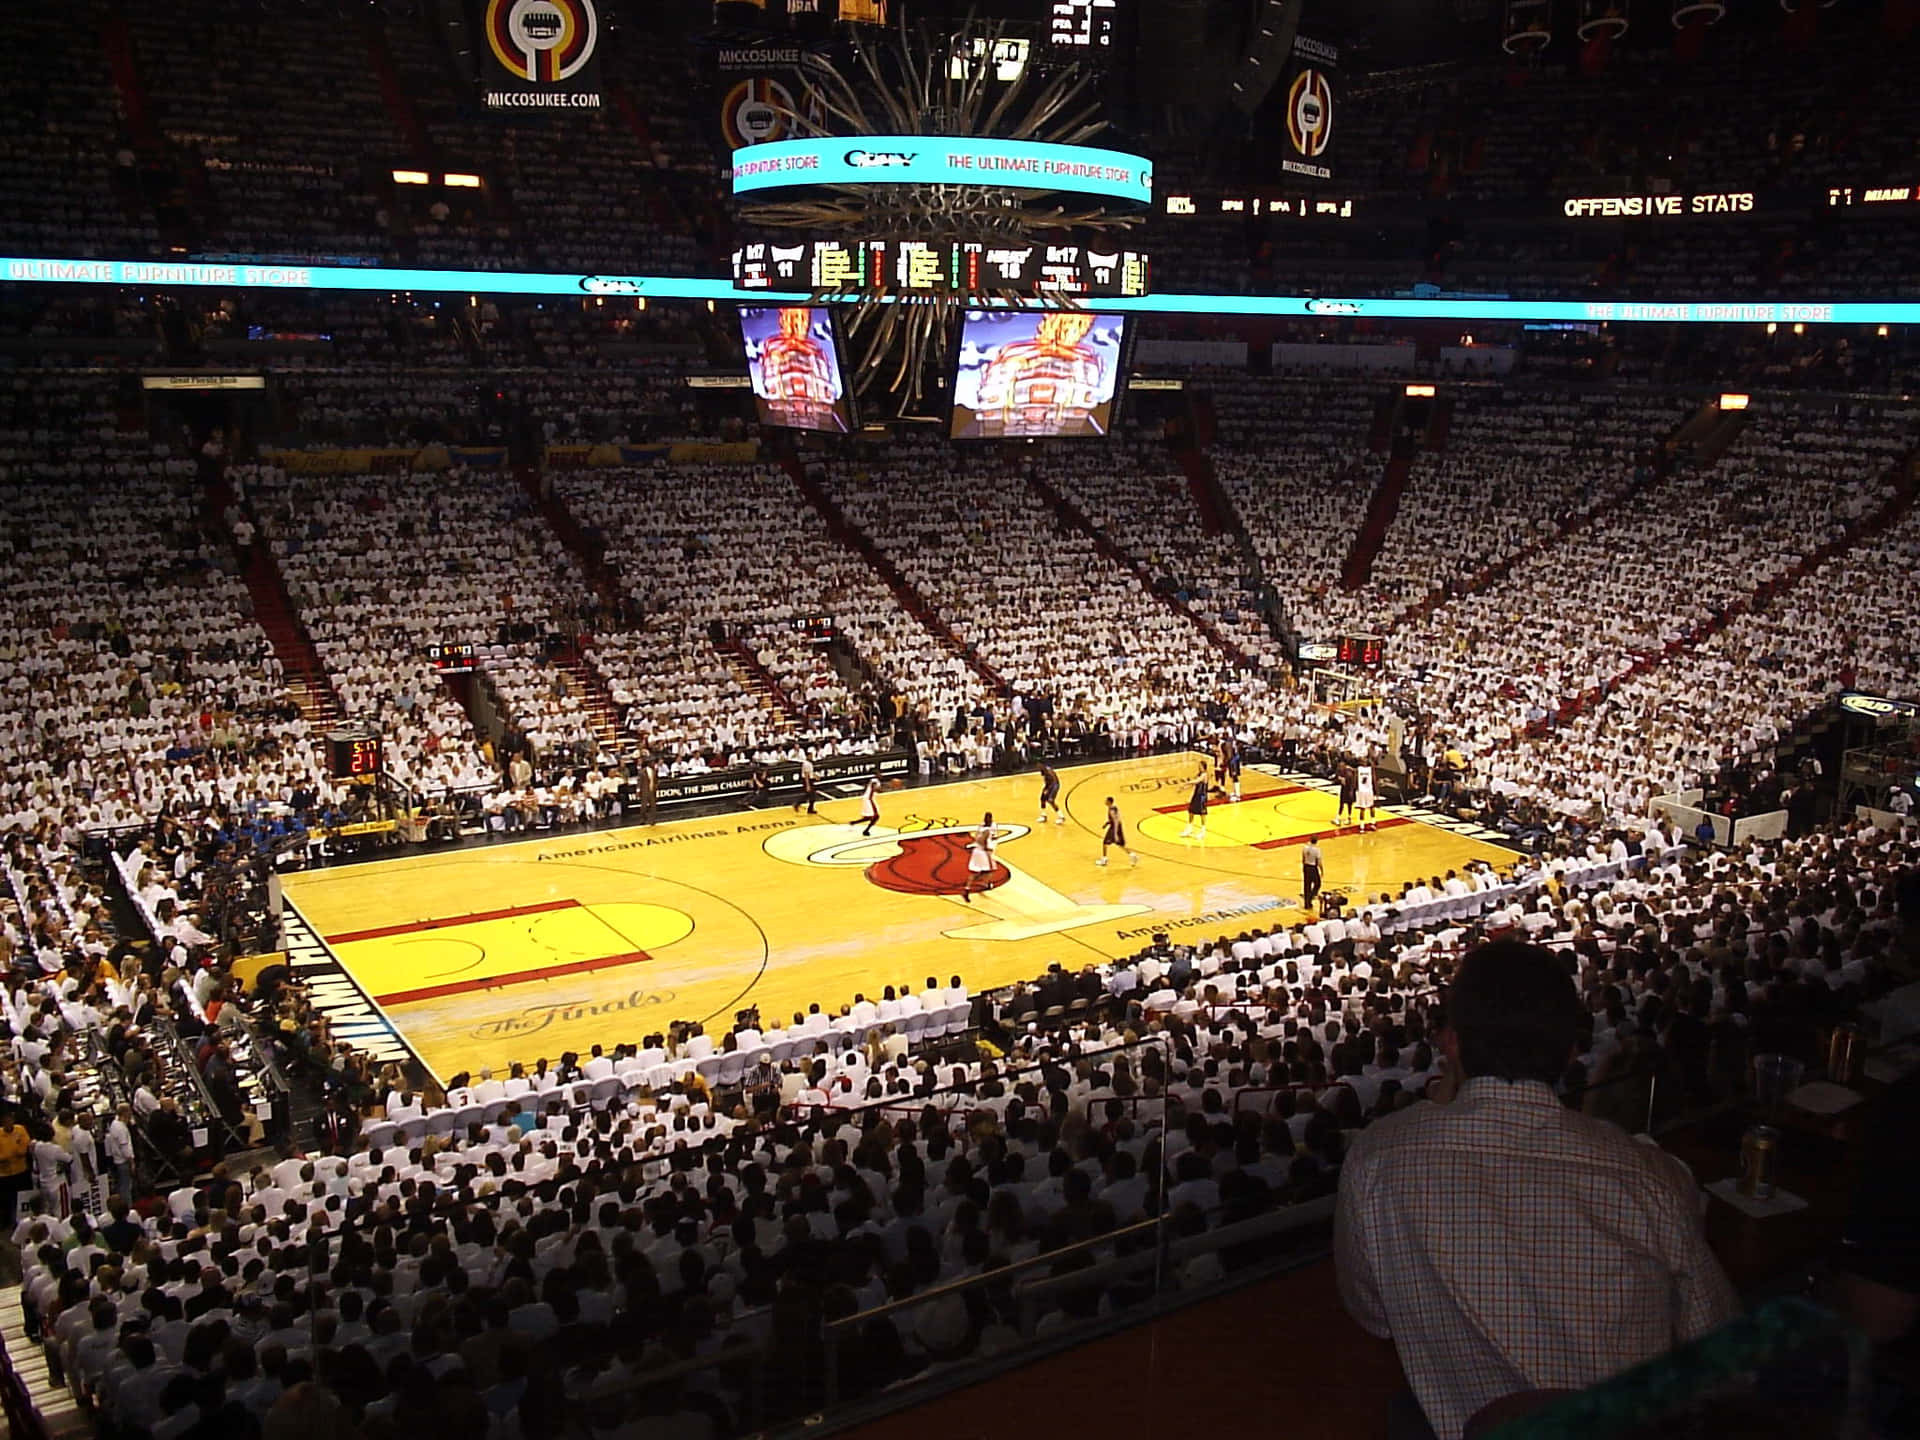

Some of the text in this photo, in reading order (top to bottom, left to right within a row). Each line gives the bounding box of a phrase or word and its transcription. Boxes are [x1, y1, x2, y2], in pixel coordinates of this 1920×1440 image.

[719, 49, 801, 63] MICCOSUKEE
[487, 92, 601, 107] MICCOSUKEE.COM
[785, 155, 819, 170] STORE
[948, 155, 972, 169] THE
[978, 156, 1039, 173] ULTIMATE
[1044, 160, 1103, 179] FURNITURE
[1105, 167, 1129, 183] STORE
[1864, 188, 1910, 202] MIAMI
[1564, 194, 1753, 217] OFFENSIVE STATS
[10, 262, 311, 285] ULTIMATE FURNITURE STORE
[1588, 305, 1832, 320] THE ULTIMATE FURNITURE STORE
[354, 740, 377, 753] 5:17
[352, 752, 374, 772] 21
[684, 785, 699, 795] THE
[537, 819, 797, 862] AmericanAirlines Arena
[1115, 897, 1297, 942] AmericanAirlines
[476, 991, 676, 1034] The Finals
